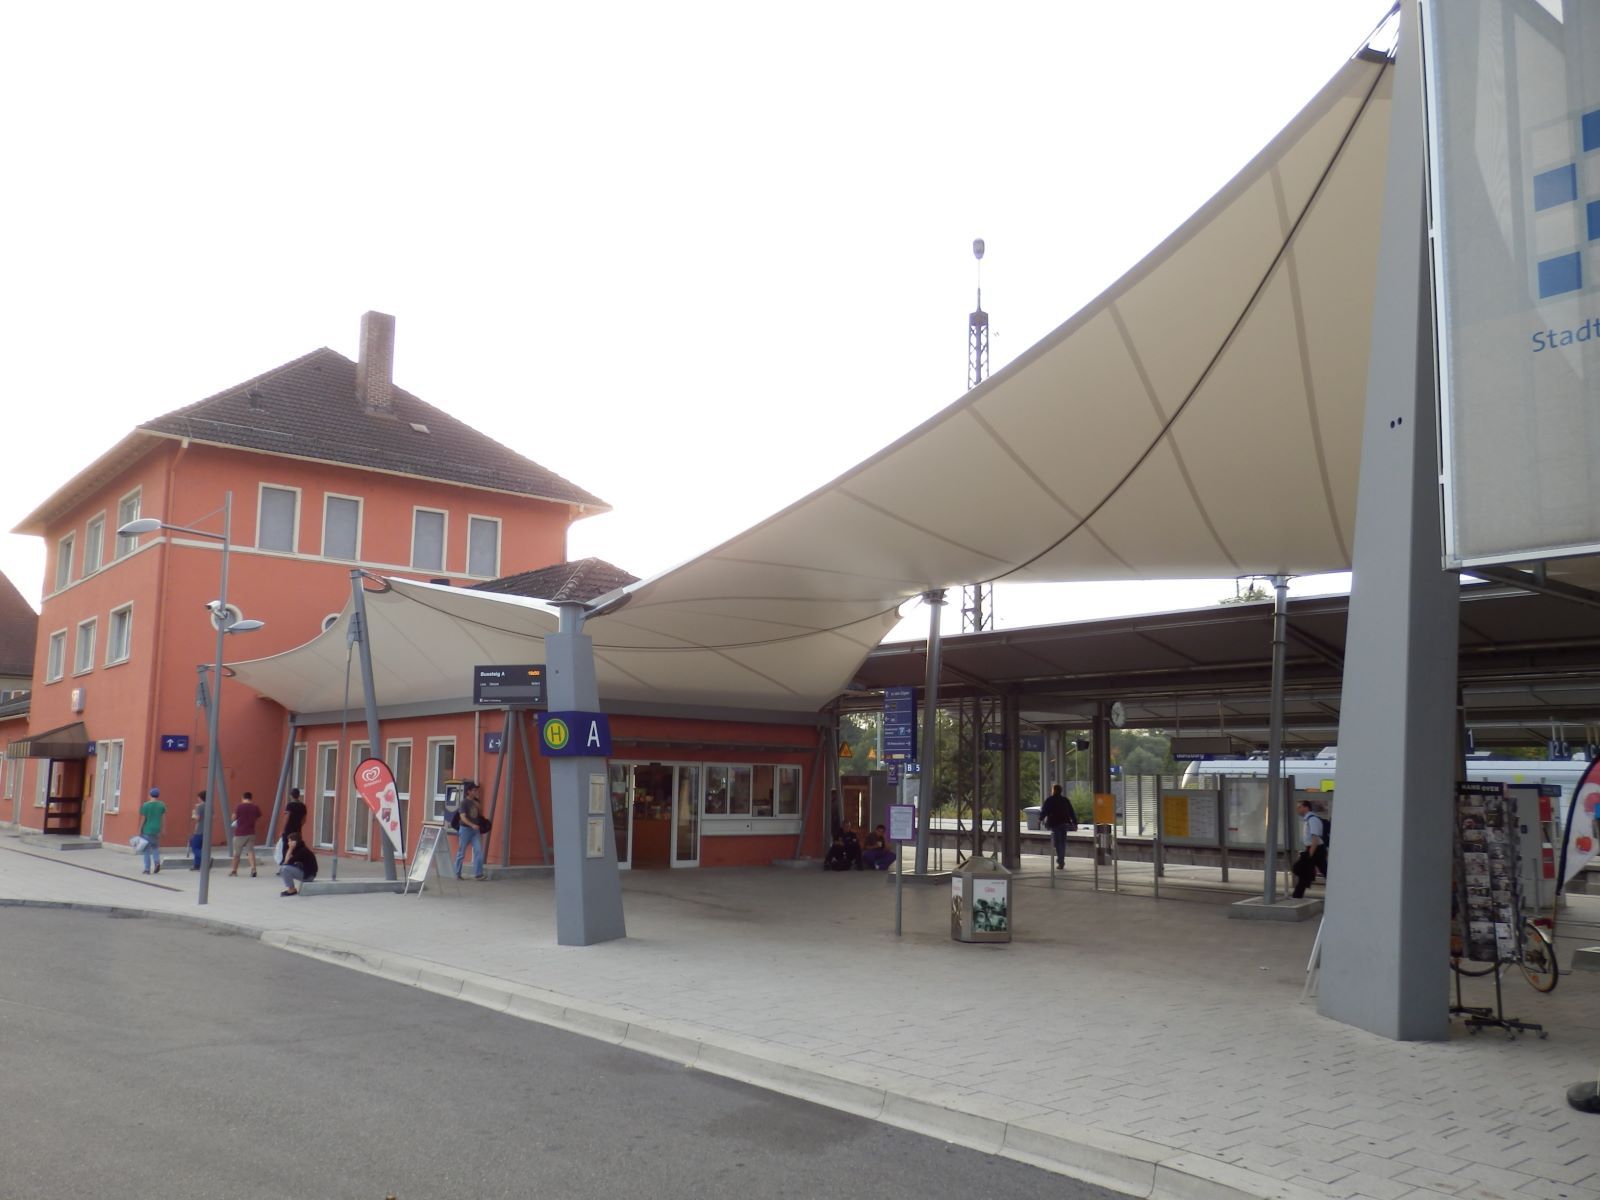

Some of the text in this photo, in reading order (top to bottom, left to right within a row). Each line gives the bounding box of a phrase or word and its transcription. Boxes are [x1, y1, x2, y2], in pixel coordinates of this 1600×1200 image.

[1532, 317, 1600, 353] Stadt
[550, 725, 561, 742] H
[587, 720, 600, 747] A
